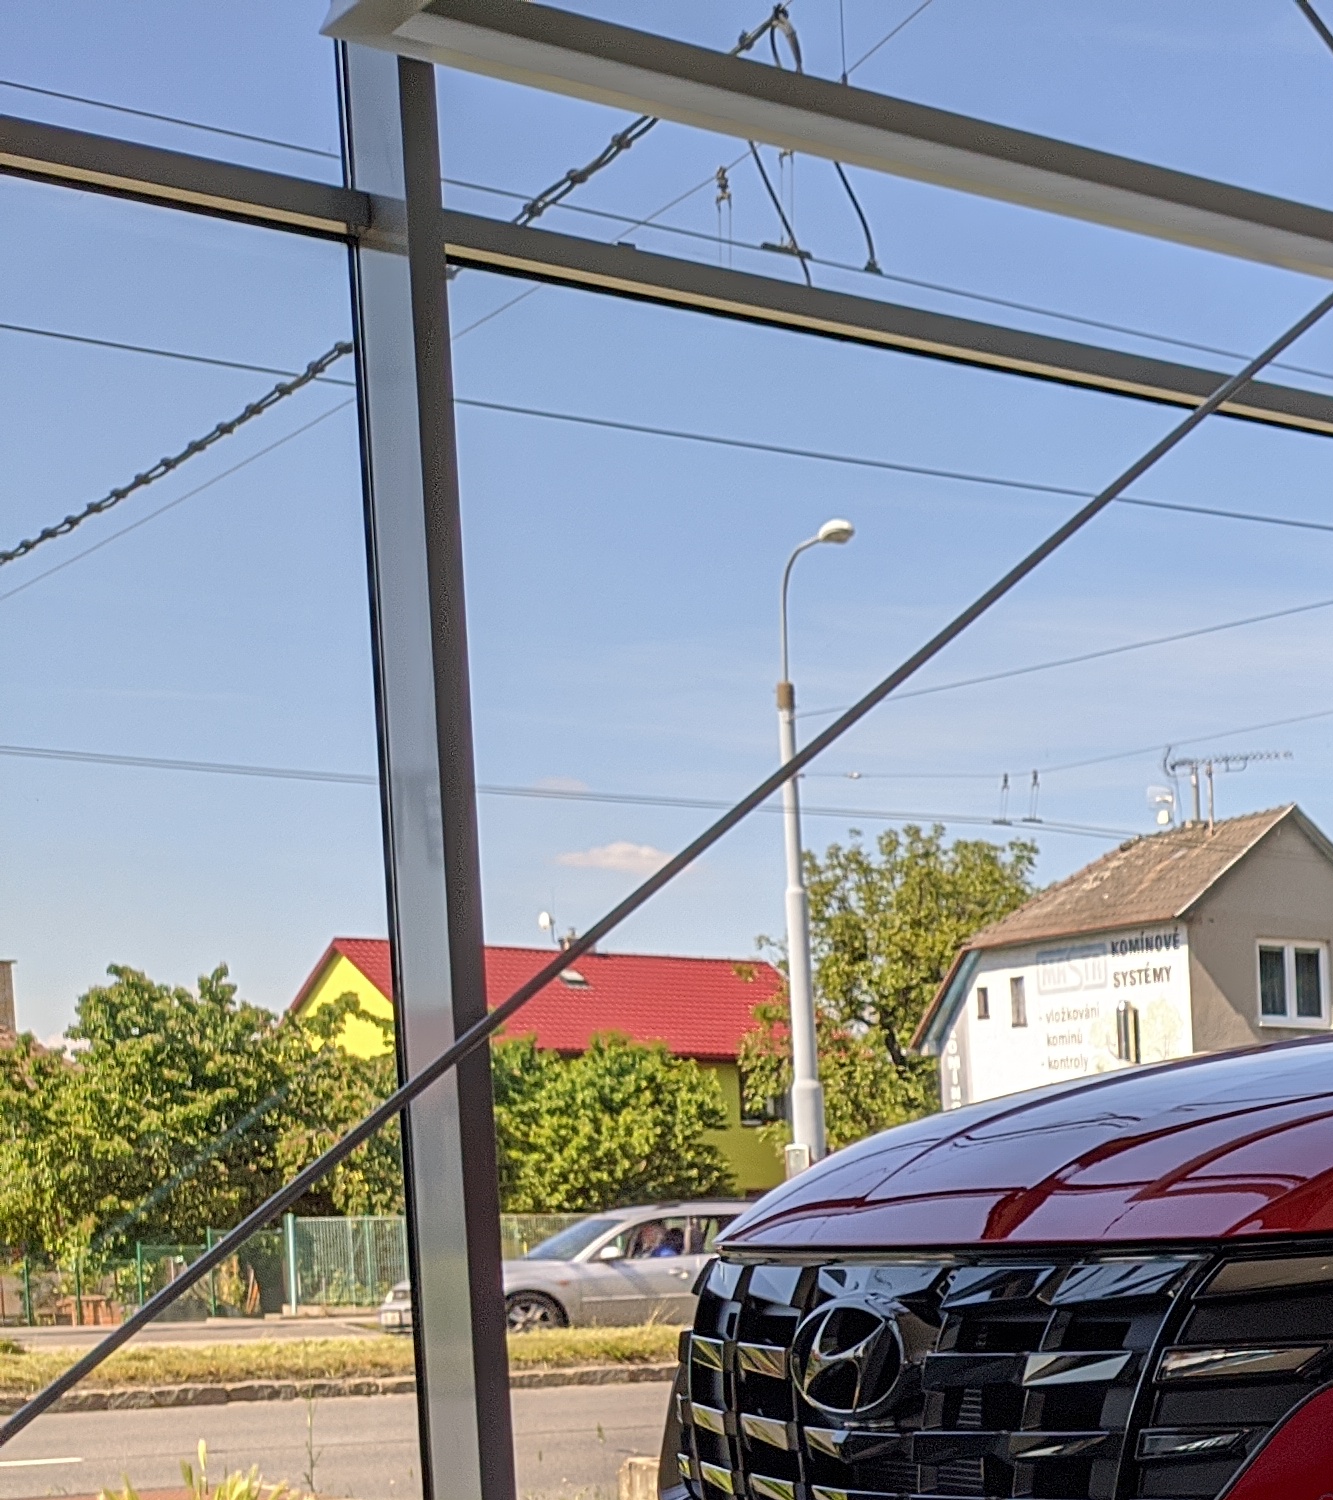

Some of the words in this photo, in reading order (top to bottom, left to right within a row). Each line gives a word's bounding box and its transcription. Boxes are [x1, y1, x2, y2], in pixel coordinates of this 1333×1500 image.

[1111, 928, 1181, 956] KOMÍNOVÉ
[1113, 962, 1172, 988] SYSTÉMY
[1045, 1002, 1100, 1023] vložkování
[1048, 1054, 1089, 1071] kontroly
